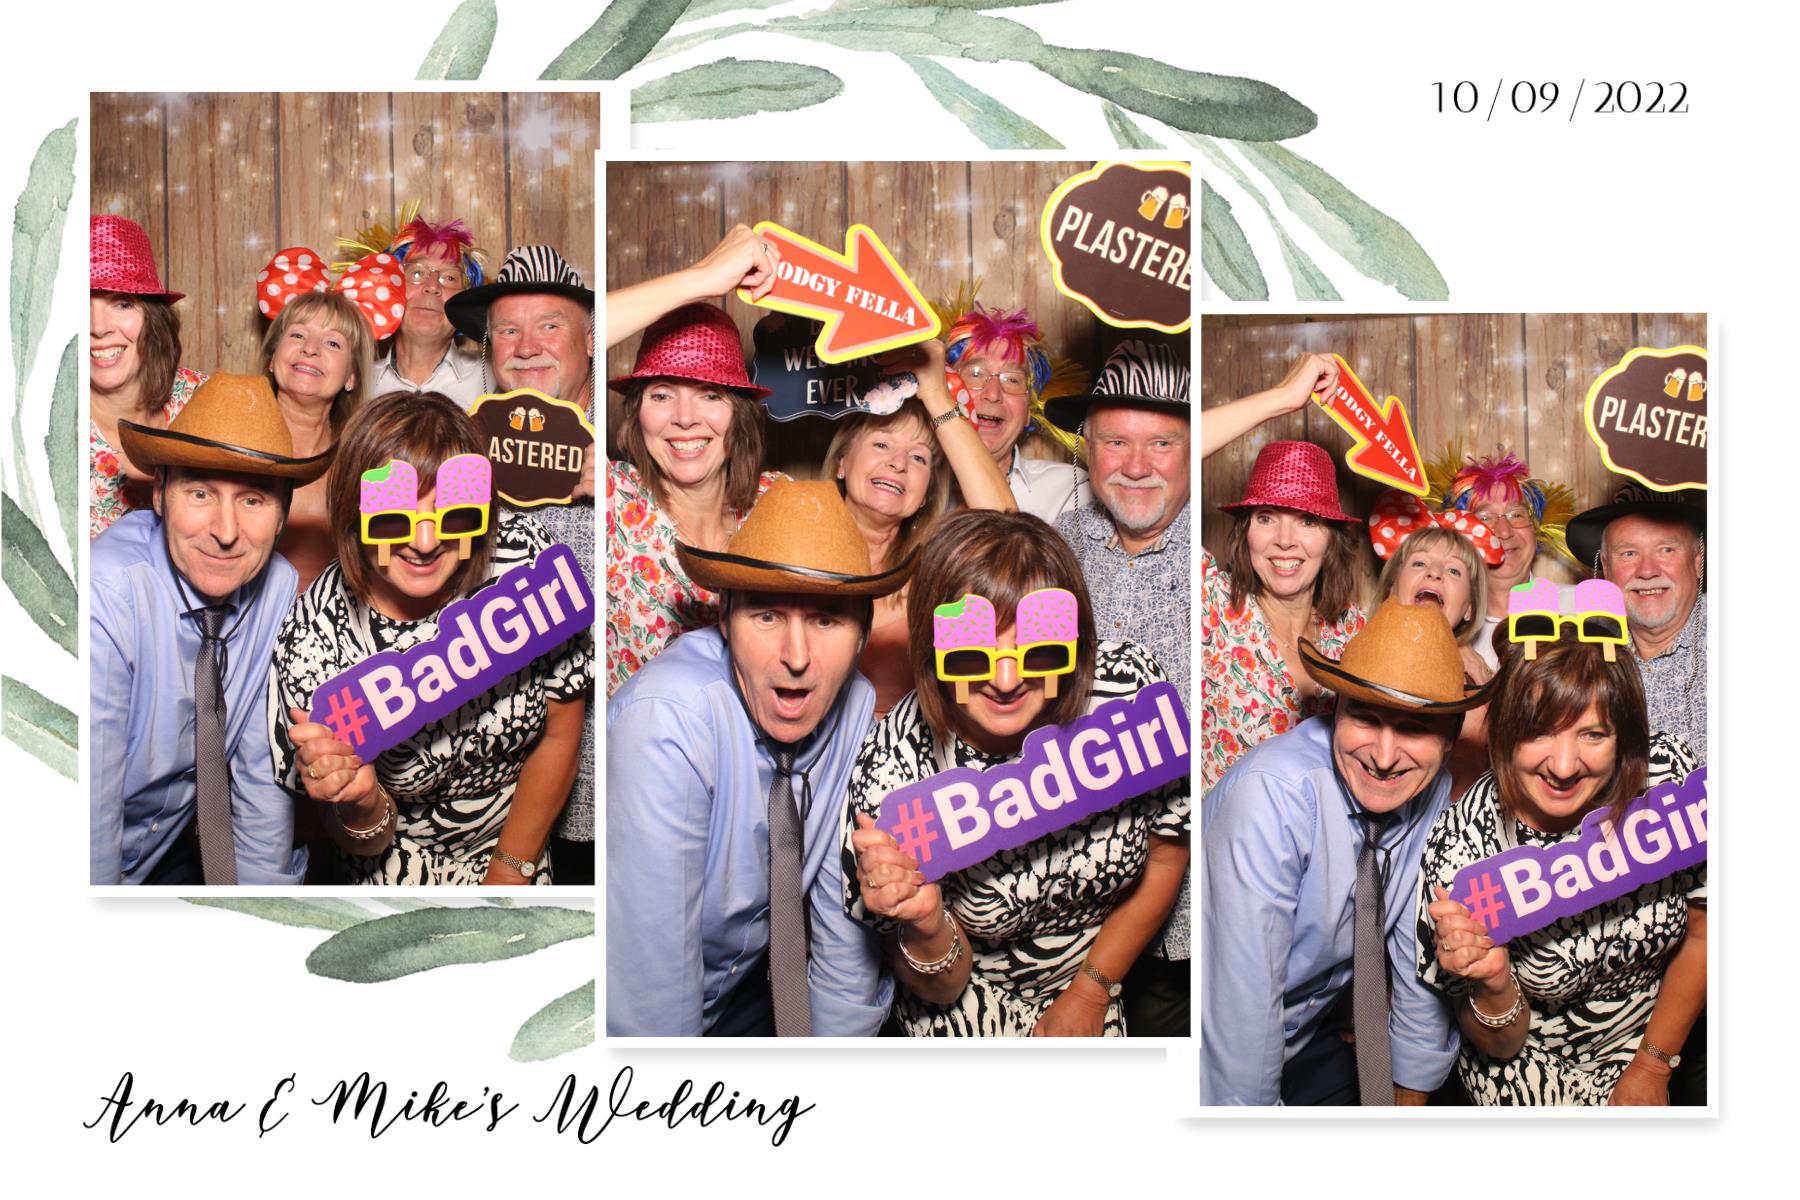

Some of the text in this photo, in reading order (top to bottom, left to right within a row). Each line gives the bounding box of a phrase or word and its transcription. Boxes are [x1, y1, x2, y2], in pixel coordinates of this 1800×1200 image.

[777, 260, 916, 327] ODGY FELLA
[806, 375, 863, 409] EVER
[1598, 395, 1708, 449] PLASTER
[488, 436, 583, 473] ASTERED
[1336, 386, 1417, 481] ODGY FELLA
[324, 554, 588, 747] #BadGirl
[892, 693, 1189, 864] #BadGirl
[1463, 779, 1708, 930] #BadGir
